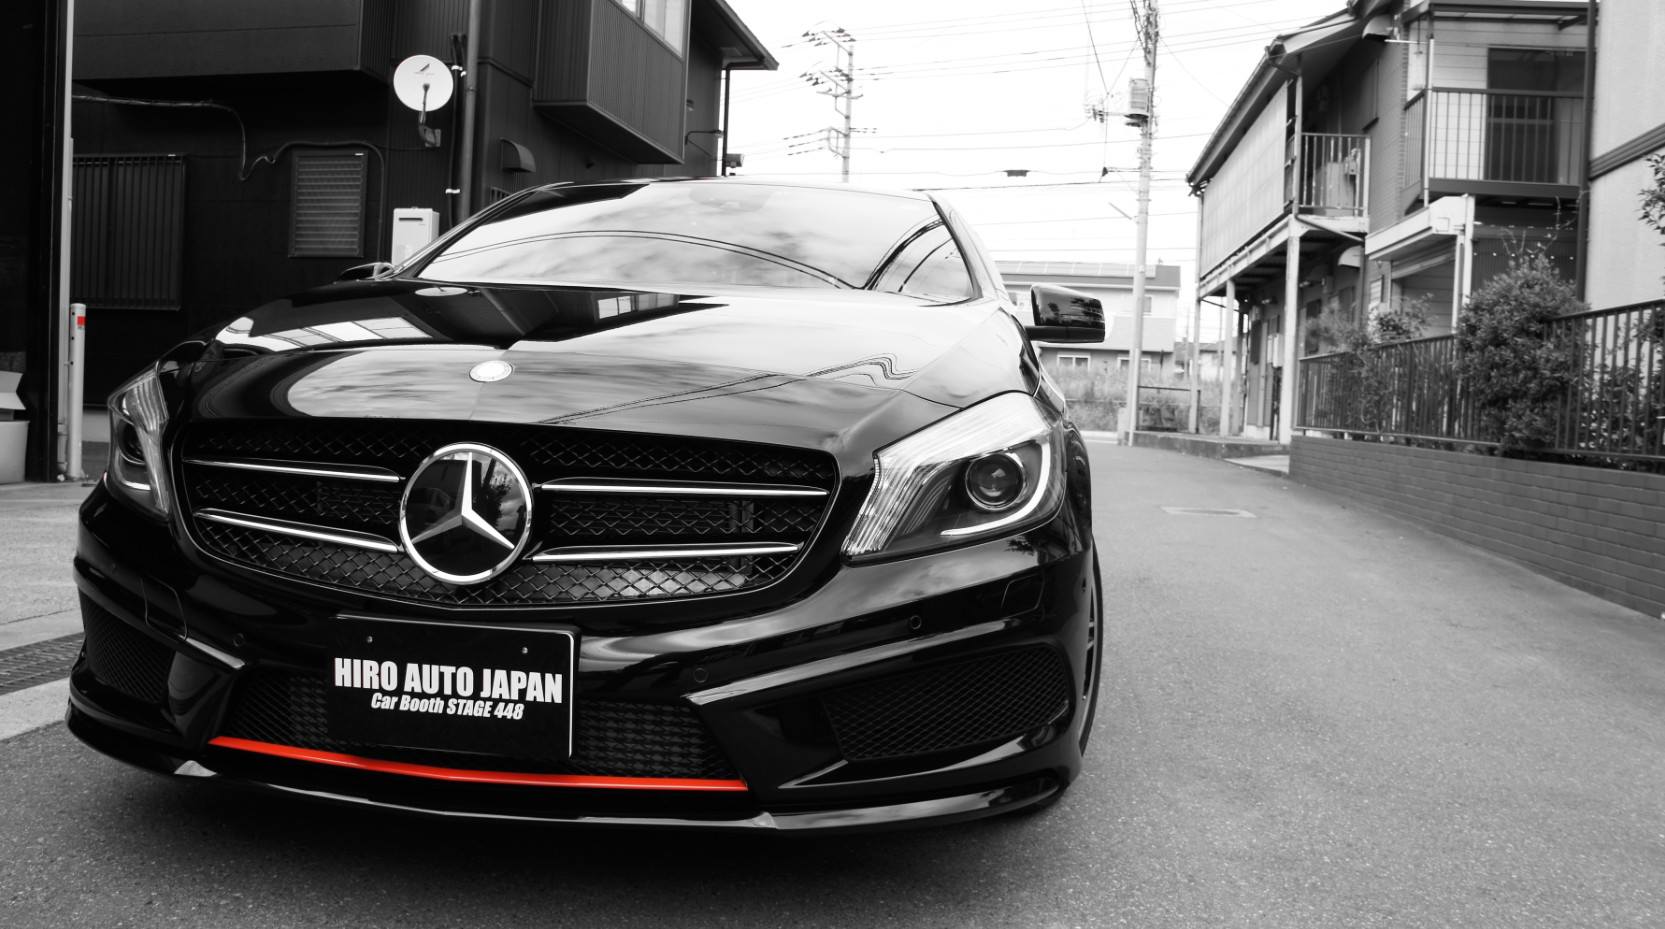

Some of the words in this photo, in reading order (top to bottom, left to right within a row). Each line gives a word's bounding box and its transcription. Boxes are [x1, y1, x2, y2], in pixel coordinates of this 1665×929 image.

[334, 657, 398, 691] HIRO
[404, 662, 474, 697] AUTO
[480, 668, 563, 703] JAPAN
[371, 692, 398, 710] Car
[399, 694, 444, 714] Booth
[447, 698, 493, 718] STAGE
[494, 702, 525, 720] 448
